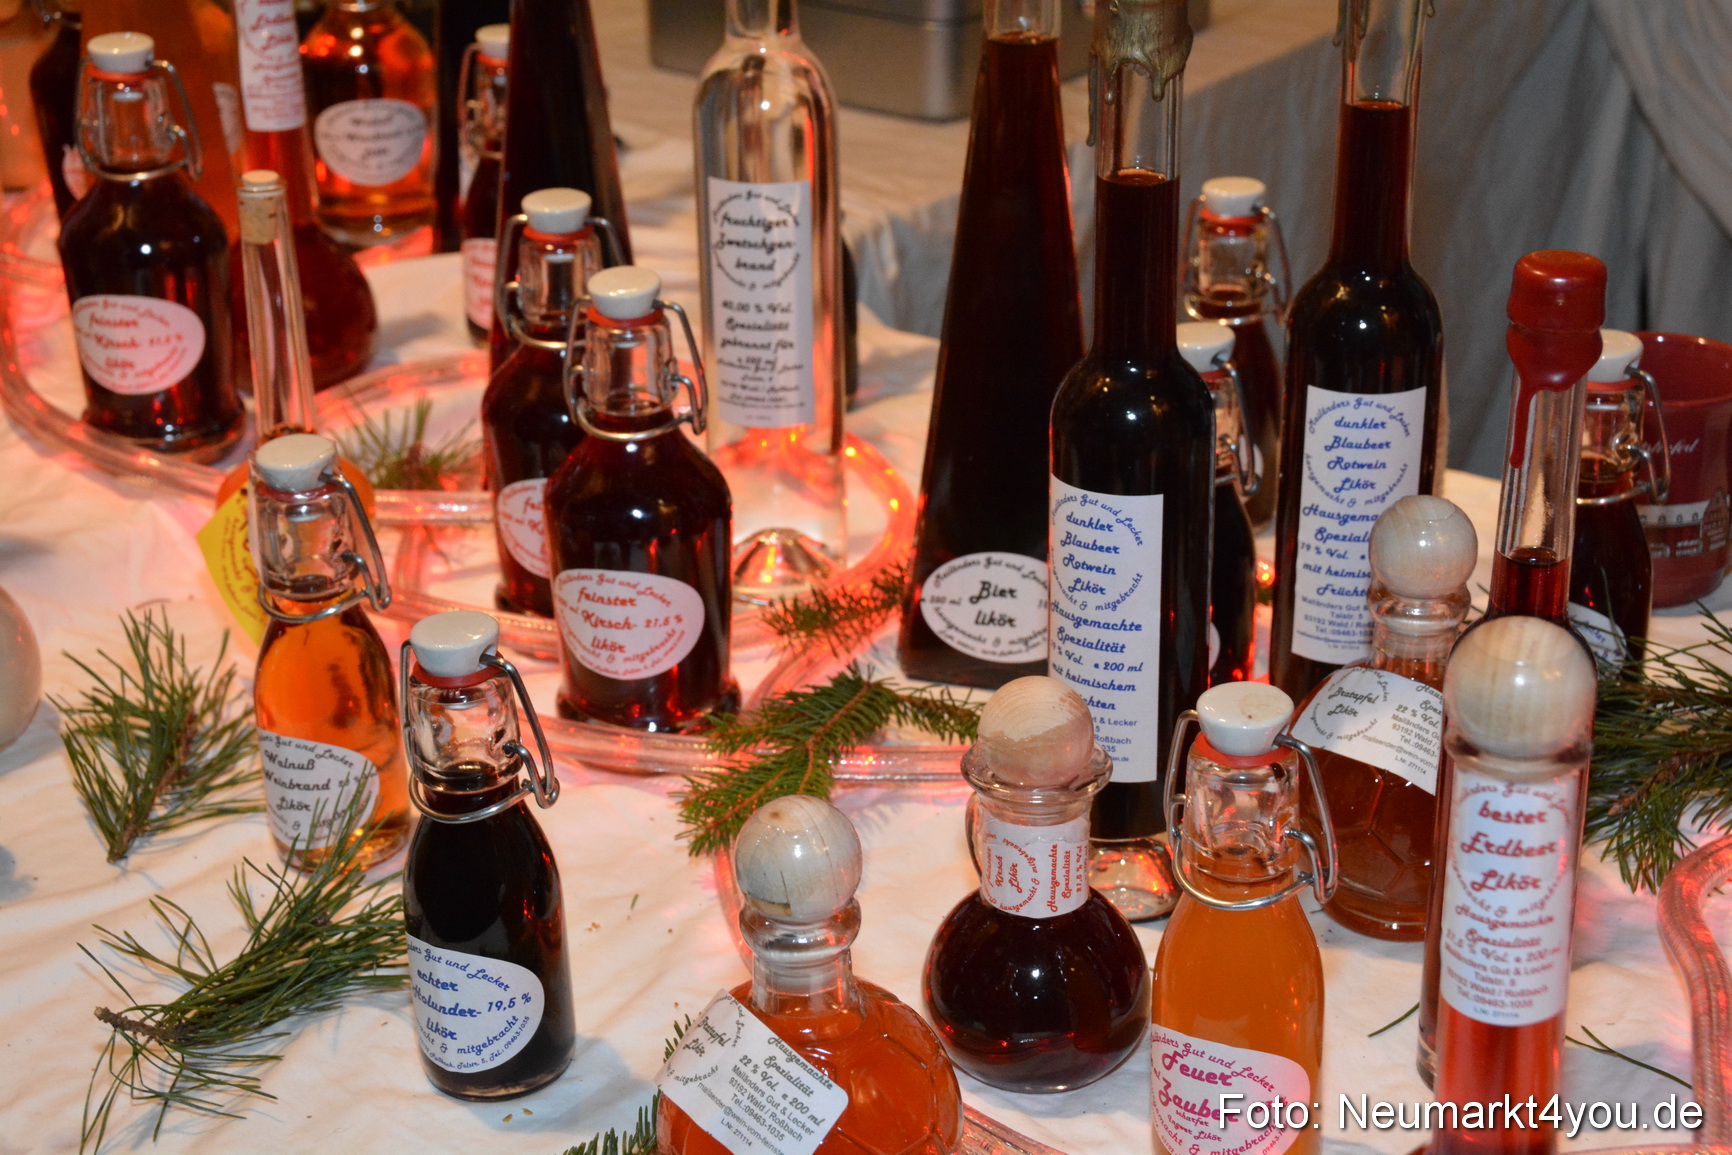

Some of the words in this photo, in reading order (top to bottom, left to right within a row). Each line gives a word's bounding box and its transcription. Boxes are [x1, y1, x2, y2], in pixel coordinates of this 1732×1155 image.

[1353, 397, 1374, 410] Gut
[1334, 416, 1388, 430] dunkler
[1324, 435, 1392, 452] Blaubeer
[1327, 456, 1388, 470] Rotwein
[1333, 477, 1377, 494] Likör
[1065, 511, 1114, 532] dunkler
[1080, 493, 1099, 507] Gut
[1101, 503, 1122, 516] und
[1115, 517, 1144, 546] Lecker
[1302, 503, 1379, 526] Hausgema
[1060, 530, 1120, 554] Blaubeer
[1314, 526, 1370, 544] Spezial
[1062, 553, 1116, 575] Rotwein
[1302, 563, 1323, 574] mit
[1325, 565, 1371, 578] heimisc
[577, 586, 638, 607] feinster
[968, 580, 1018, 604] Bier
[1067, 577, 1107, 595] Likör
[1095, 572, 1144, 612] mitgebracht
[1316, 584, 1368, 597] Frücht
[1051, 599, 1143, 632] Hausgemachte
[591, 635, 627, 654] likör
[1056, 626, 1127, 653] Spezialität
[1065, 649, 1084, 666] Vol.
[1103, 661, 1125, 673] 200
[1127, 662, 1144, 673] ml
[1065, 669, 1137, 692] heimischem
[1108, 718, 1138, 727] Lecker
[1391, 713, 1431, 735] Mailänders
[1399, 734, 1438, 758] Tel.:09463-
[1414, 732, 1434, 746] Wald
[263, 749, 316, 771] Walnuß
[315, 748, 355, 769] Lecker
[263, 767, 332, 791] Weinbrand
[275, 795, 312, 812] Likör
[1478, 800, 1548, 824] bester
[1460, 831, 1556, 857] Erdbeer
[1008, 862, 1023, 894] Likör
[1046, 843, 1060, 913] Hausgemachte
[1061, 849, 1073, 899] Spezialität
[1470, 869, 1541, 891] Likör
[417, 968, 459, 992] echter
[424, 947, 443, 962] Gut
[445, 958, 471, 972] und
[466, 968, 511, 992] Lecker
[521, 991, 532, 1005] %
[426, 1017, 458, 1041] likör
[456, 1014, 520, 1056] mitgebracht
[767, 1035, 834, 1090] Hausgemachte
[1161, 1050, 1233, 1087] Feuer
[1183, 1042, 1207, 1058] Gut
[1208, 1055, 1237, 1070] und
[1231, 1066, 1276, 1093] Lecker
[763, 1055, 815, 1098] Spezialität
[731, 1064, 767, 1098] Mailänders
[765, 1094, 783, 1111] Gut
[779, 1106, 788, 1116] &
[787, 1112, 815, 1137] Lecker
[739, 1054, 753, 1068] 22
[750, 1063, 760, 1075] %
[759, 1070, 777, 1092] Vol.
[788, 1096, 811, 1116] 200
[807, 1111, 826, 1128] ml
[697, 1081, 786, 1155] mailaender@wein-vom-feinste
[728, 1076, 747, 1097] 93192
[745, 1093, 767, 1113] Wald
[768, 1111, 804, 1143] Roßbach
[733, 1127, 754, 1148] 271114
[1193, 1130, 1222, 1143] Likör
[1210, 1120, 1277, 1155] mitgebrach
